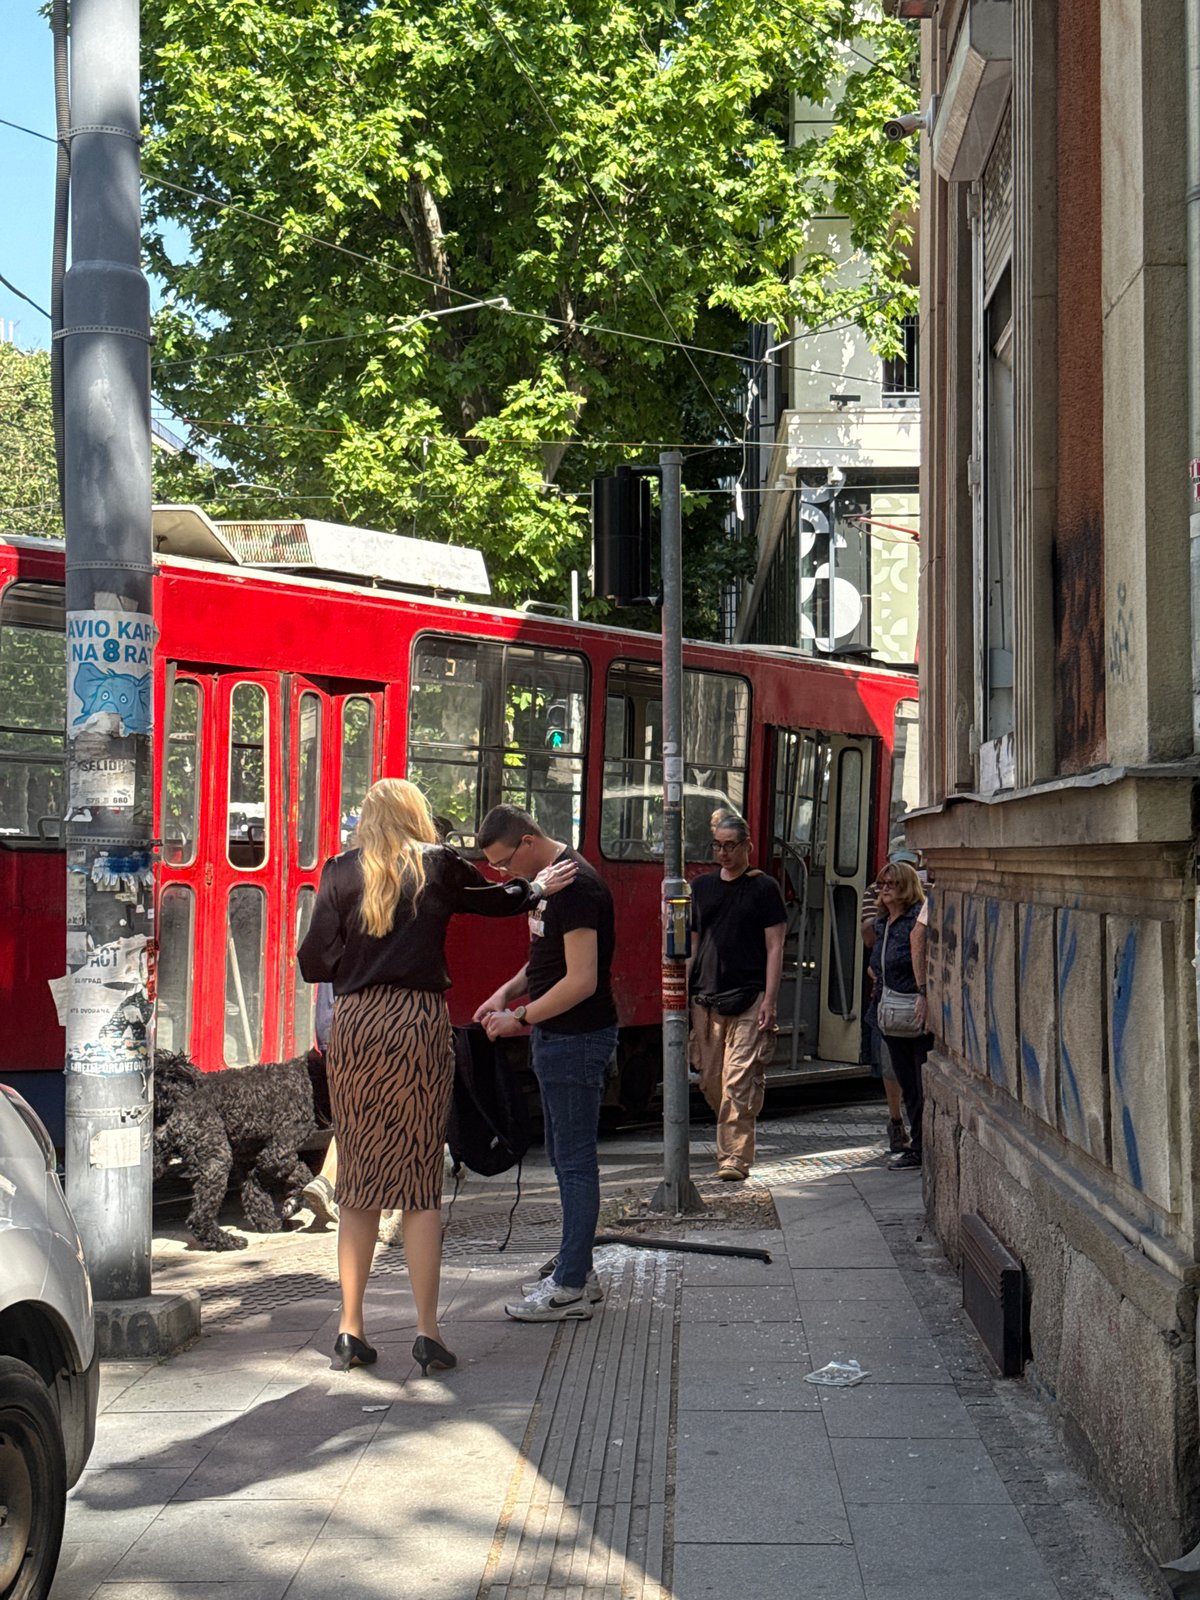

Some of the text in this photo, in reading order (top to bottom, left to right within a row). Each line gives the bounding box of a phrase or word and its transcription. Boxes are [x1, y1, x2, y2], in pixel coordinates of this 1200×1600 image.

[68, 619, 110, 638] AVIO
[72, 643, 99, 662] NA
[103, 638, 120, 663] 8
